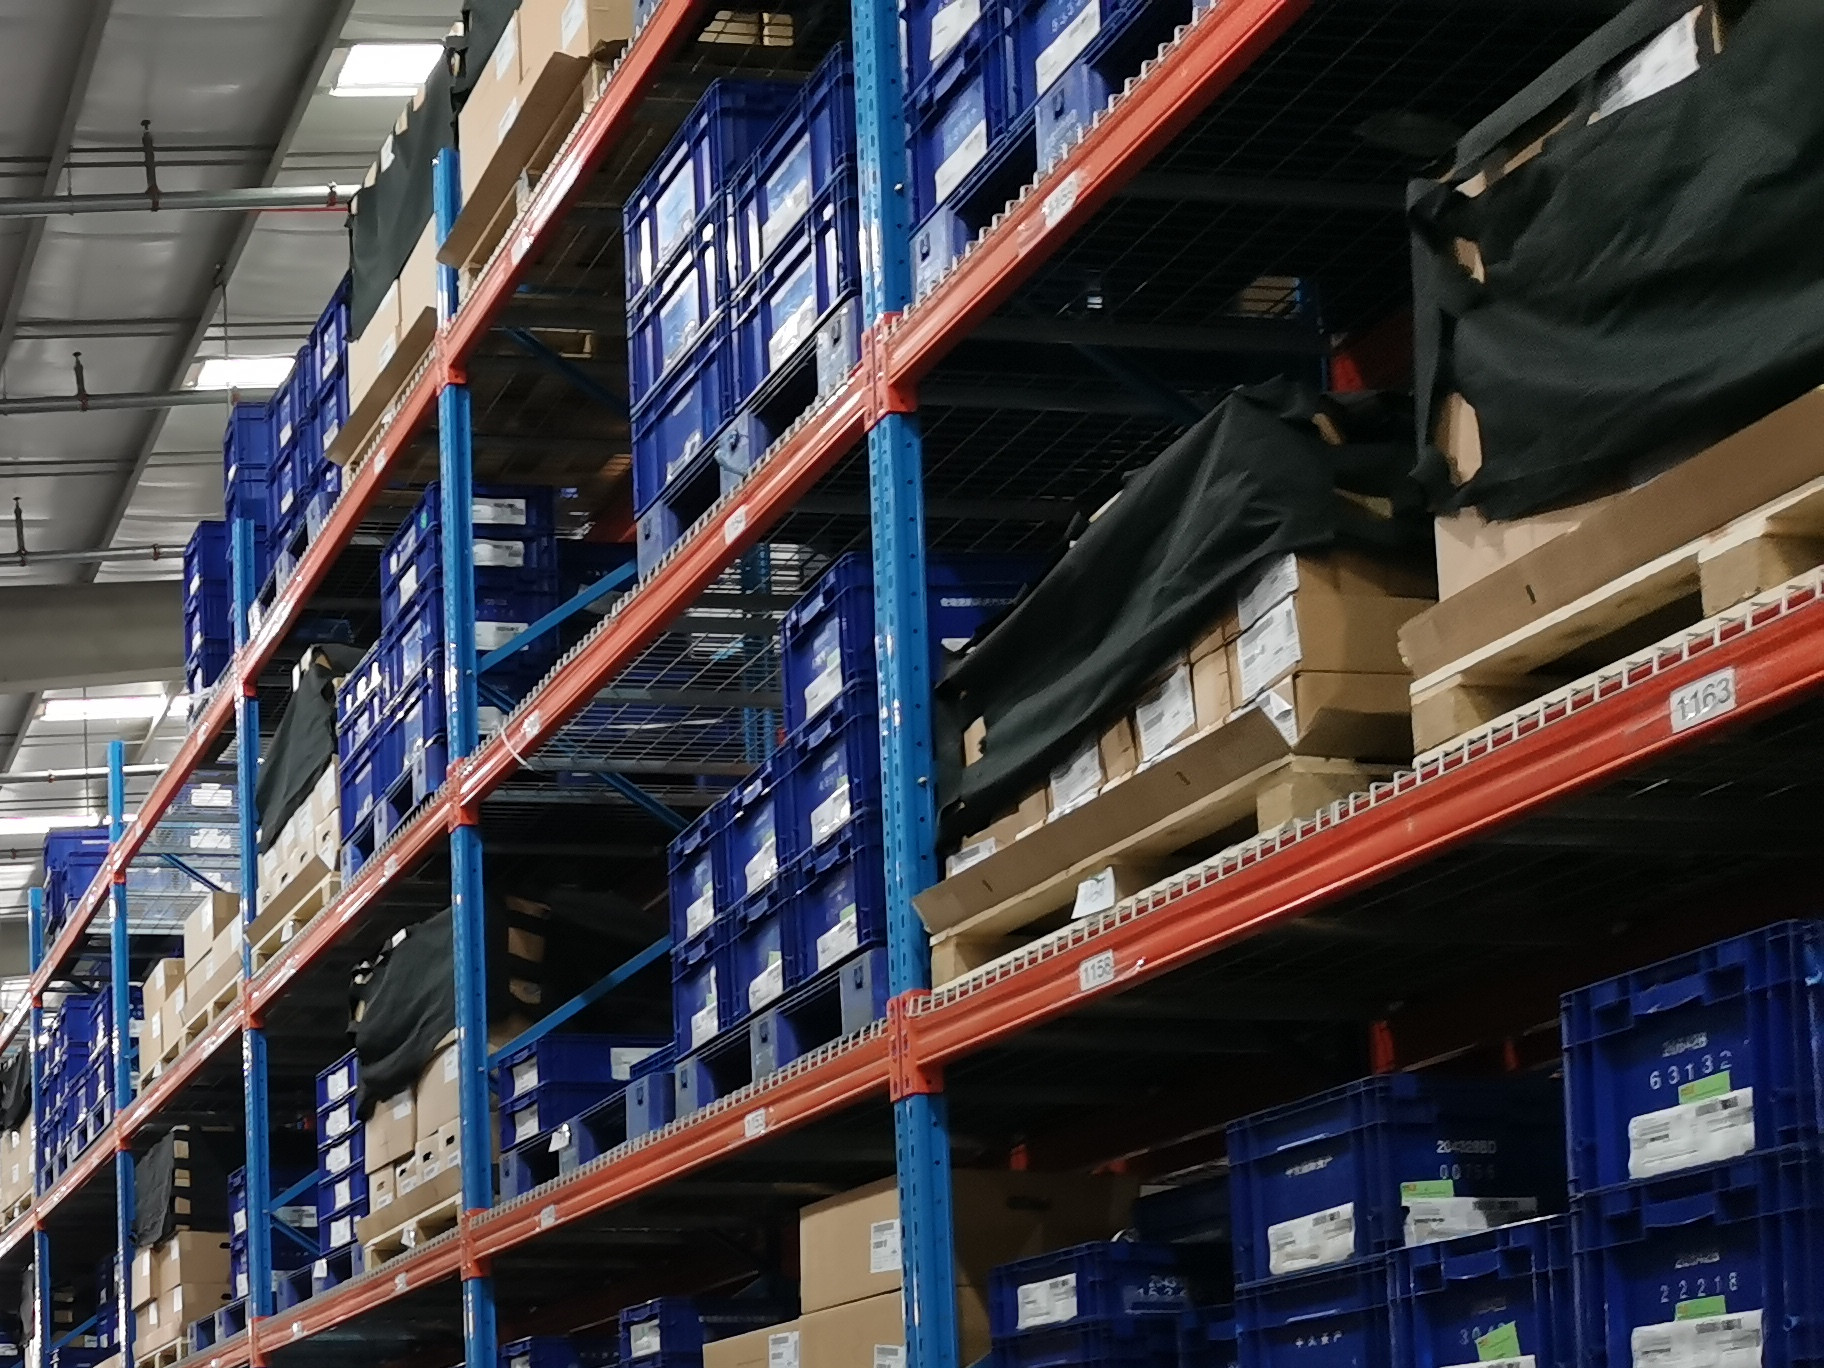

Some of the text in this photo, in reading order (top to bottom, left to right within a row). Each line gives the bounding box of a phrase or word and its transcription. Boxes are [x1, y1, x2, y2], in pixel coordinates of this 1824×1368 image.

[1677, 677, 1731, 721] 1163
[1648, 1049, 1733, 1091] 63132
[1659, 1271, 1738, 1304] 22218
